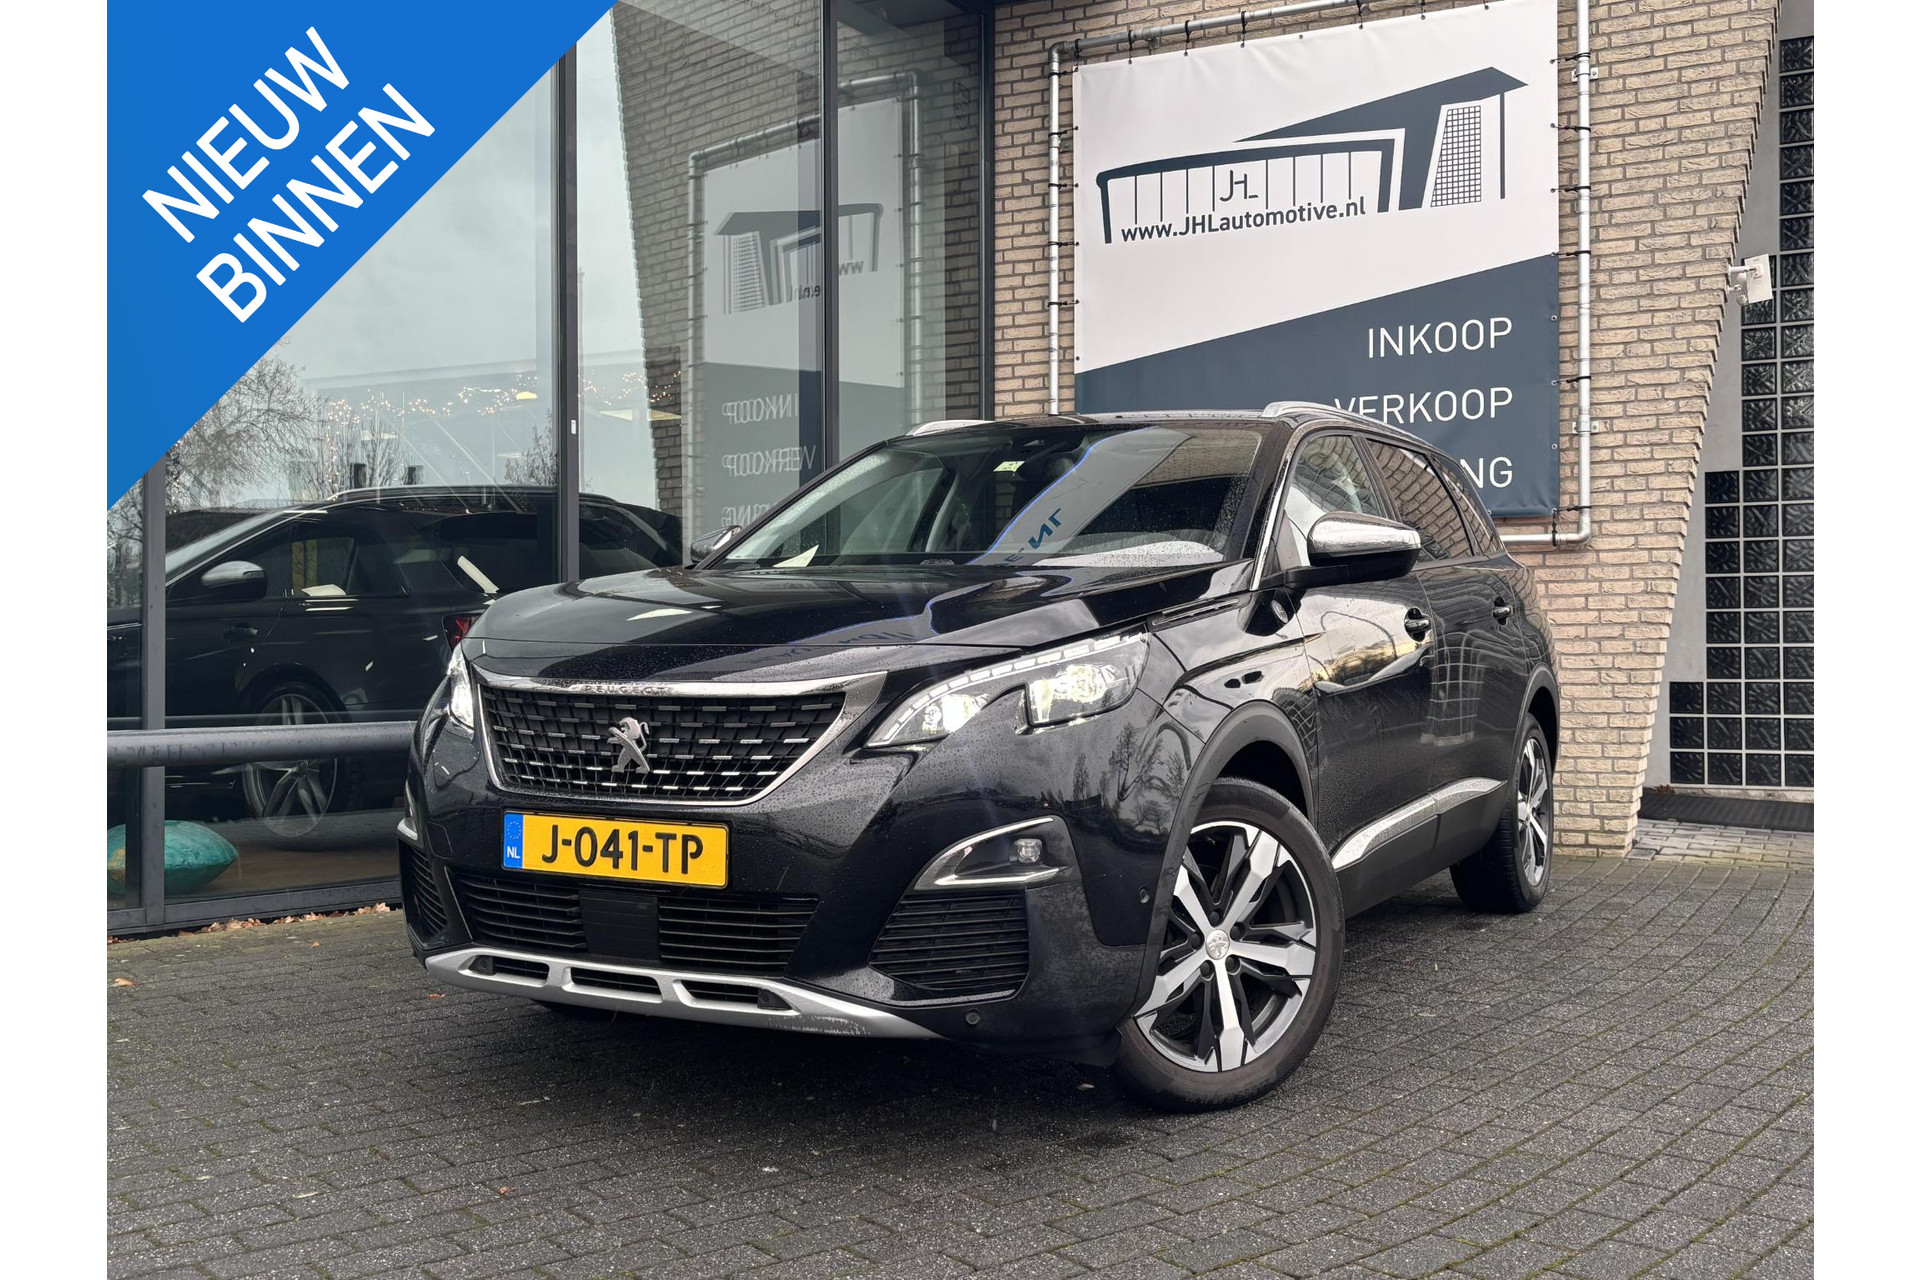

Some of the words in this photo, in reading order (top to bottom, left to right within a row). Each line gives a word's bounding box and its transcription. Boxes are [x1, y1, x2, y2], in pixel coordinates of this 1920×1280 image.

[1121, 196, 1366, 242] www.JHLautomotive.nl
[1368, 316, 1513, 358] INKOOP
[1459, 456, 1513, 489] NG
[584, 684, 667, 695] PEUGEOT
[506, 846, 521, 859] NL
[541, 824, 704, 875] J-041-TP
